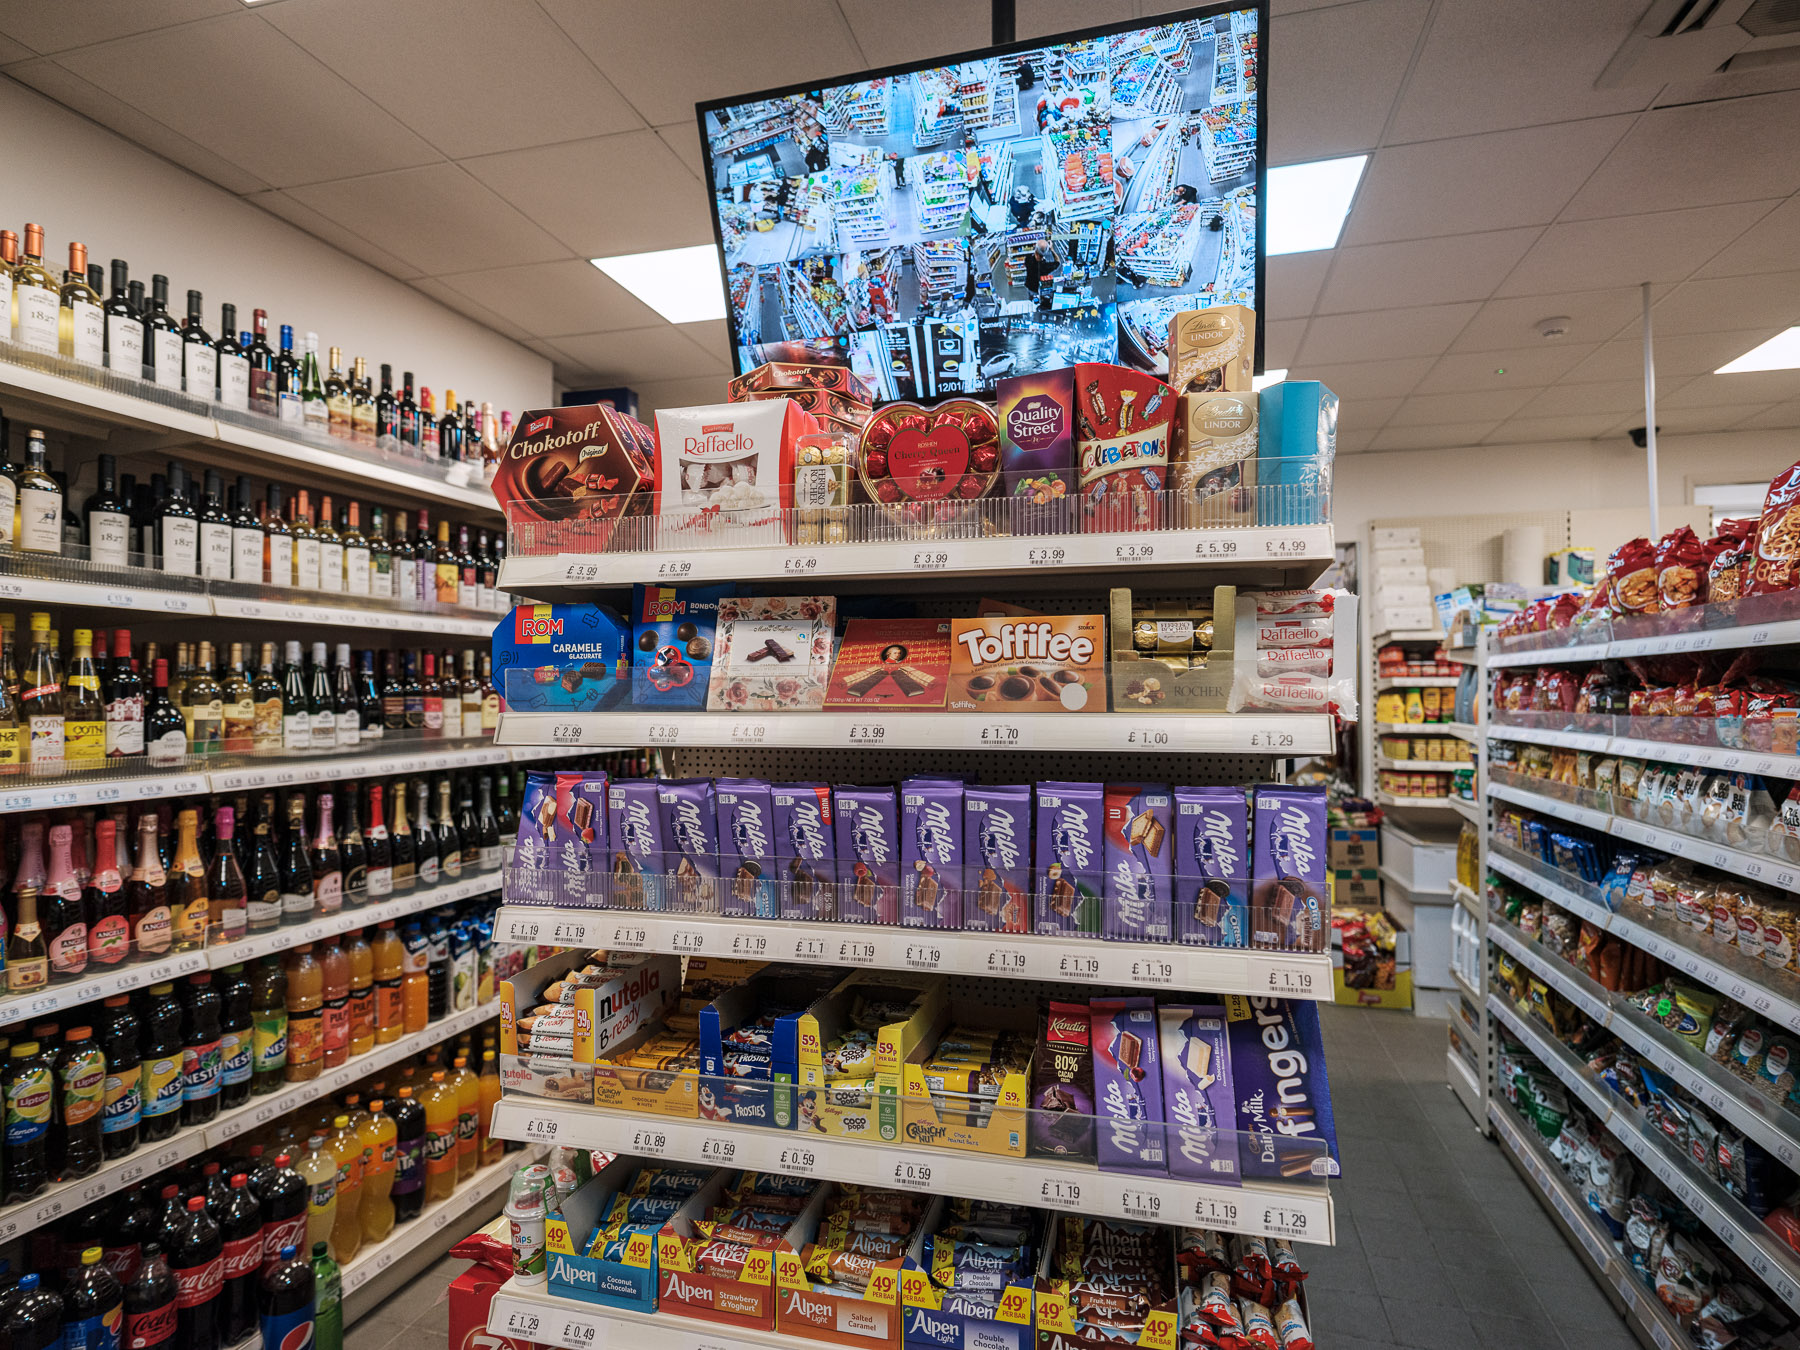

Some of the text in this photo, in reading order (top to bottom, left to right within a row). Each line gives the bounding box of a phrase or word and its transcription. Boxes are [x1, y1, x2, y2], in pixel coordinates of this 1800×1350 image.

[1191, 331, 1224, 342] LINDOR
[773, 368, 812, 377] Chokotoff
[1008, 406, 1062, 424] Quality
[1013, 420, 1057, 438] Street
[1204, 420, 1241, 430] LINDOR
[510, 420, 601, 460] Chokotoff
[684, 433, 754, 456] Raffaello
[917, 440, 938, 449] ROSHEN
[581, 446, 604, 458] Original
[894, 447, 960, 461] Cherry Queen
[809, 469, 818, 506] ROCHER
[818, 468, 827, 506] FERRERO
[522, 618, 564, 636] ROM
[1261, 628, 1319, 641] Raffaello
[553, 643, 602, 653] CARAMELE
[958, 623, 1094, 666] Toffifee
[1267, 649, 1325, 661] Raffaello
[539, 669, 560, 679] ROM
[1174, 685, 1225, 697] ROCHER
[1263, 683, 1325, 701] Raffaello
[950, 701, 977, 710] Toffifee
[820, 796, 830, 819] NUEVO
[626, 800, 656, 858] Milka
[671, 800, 707, 857] Milka
[738, 800, 769, 859] Milka
[858, 806, 888, 867] Milka
[925, 801, 955, 865] Milka
[1061, 803, 1094, 870] Milka
[988, 807, 1021, 872] Milka
[1203, 809, 1239, 878] Milka
[1281, 806, 1316, 877] Milka
[600, 967, 660, 1020] nutella
[537, 1018, 565, 1028] B-ready
[599, 1003, 642, 1051] B-ready
[1049, 1017, 1087, 1039] Kandia
[845, 1053, 865, 1063] pops
[1054, 1054, 1079, 1072] 80%
[76, 1073, 103, 1087] Lipton
[1057, 1070, 1074, 1078] CACAO
[20, 1093, 49, 1106] Lipton
[1250, 1090, 1267, 1123] Milk
[69, 1104, 95, 1116] Peach
[734, 1103, 766, 1118] FROSTIES
[1103, 1079, 1140, 1154] Milka
[8, 1127, 38, 1136] Lemon
[906, 1122, 947, 1139] CRUNCHY
[1171, 1087, 1210, 1164] Milka
[918, 1135, 935, 1143] NUT
[1255, 1123, 1276, 1163] Dairy
[728, 1229, 755, 1239] Strawberry
[850, 1233, 891, 1256] Alpen
[958, 1249, 1003, 1269] Alpen
[549, 1255, 596, 1285] Alpen
[607, 1275, 632, 1287] Coconut
[663, 1272, 713, 1302] Alpen
[719, 1291, 759, 1306] Strawberry
[785, 1290, 832, 1318] Alpen
[1106, 1297, 1117, 1305] Nut
[812, 1314, 829, 1325] Light
[848, 1320, 876, 1332] Caramel
[851, 1313, 874, 1323] Salted
[909, 1309, 960, 1338] Alpen
[937, 1334, 955, 1344] Light
[978, 1332, 1005, 1344] Double
